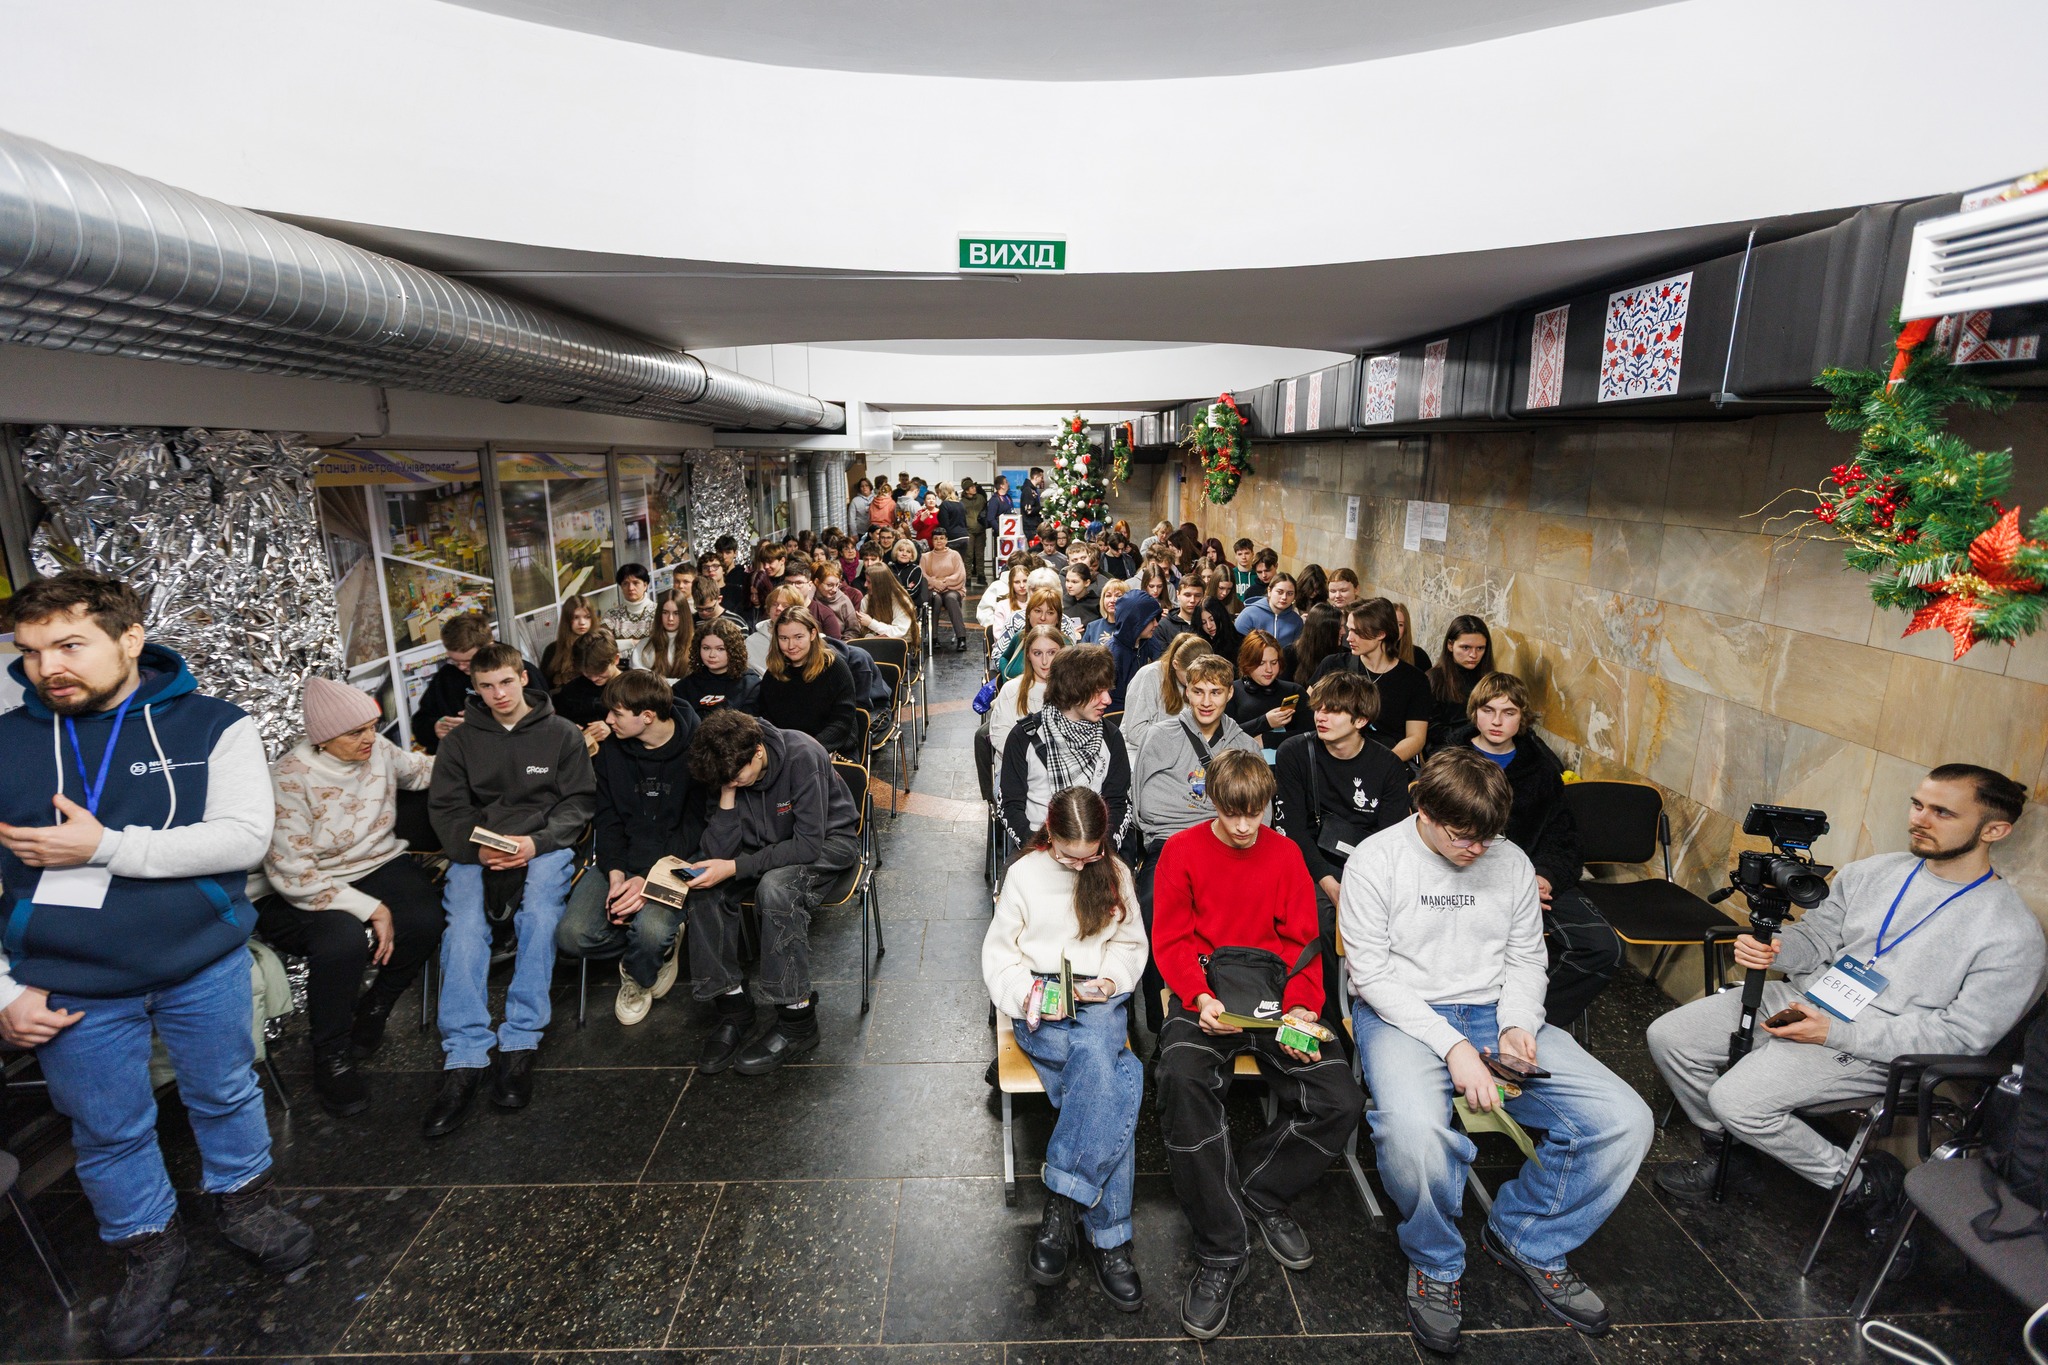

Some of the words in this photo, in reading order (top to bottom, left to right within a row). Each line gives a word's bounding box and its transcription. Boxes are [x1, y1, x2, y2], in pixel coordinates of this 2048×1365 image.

[969, 243, 1056, 268] ВИХІД
[1004, 519, 1016, 535] 2
[149, 759, 173, 767] NUE
[1421, 895, 1475, 906] MANCHESTER
[1823, 976, 1866, 1006] ЄВГЕН
[1260, 1000, 1279, 1010] NIKE
